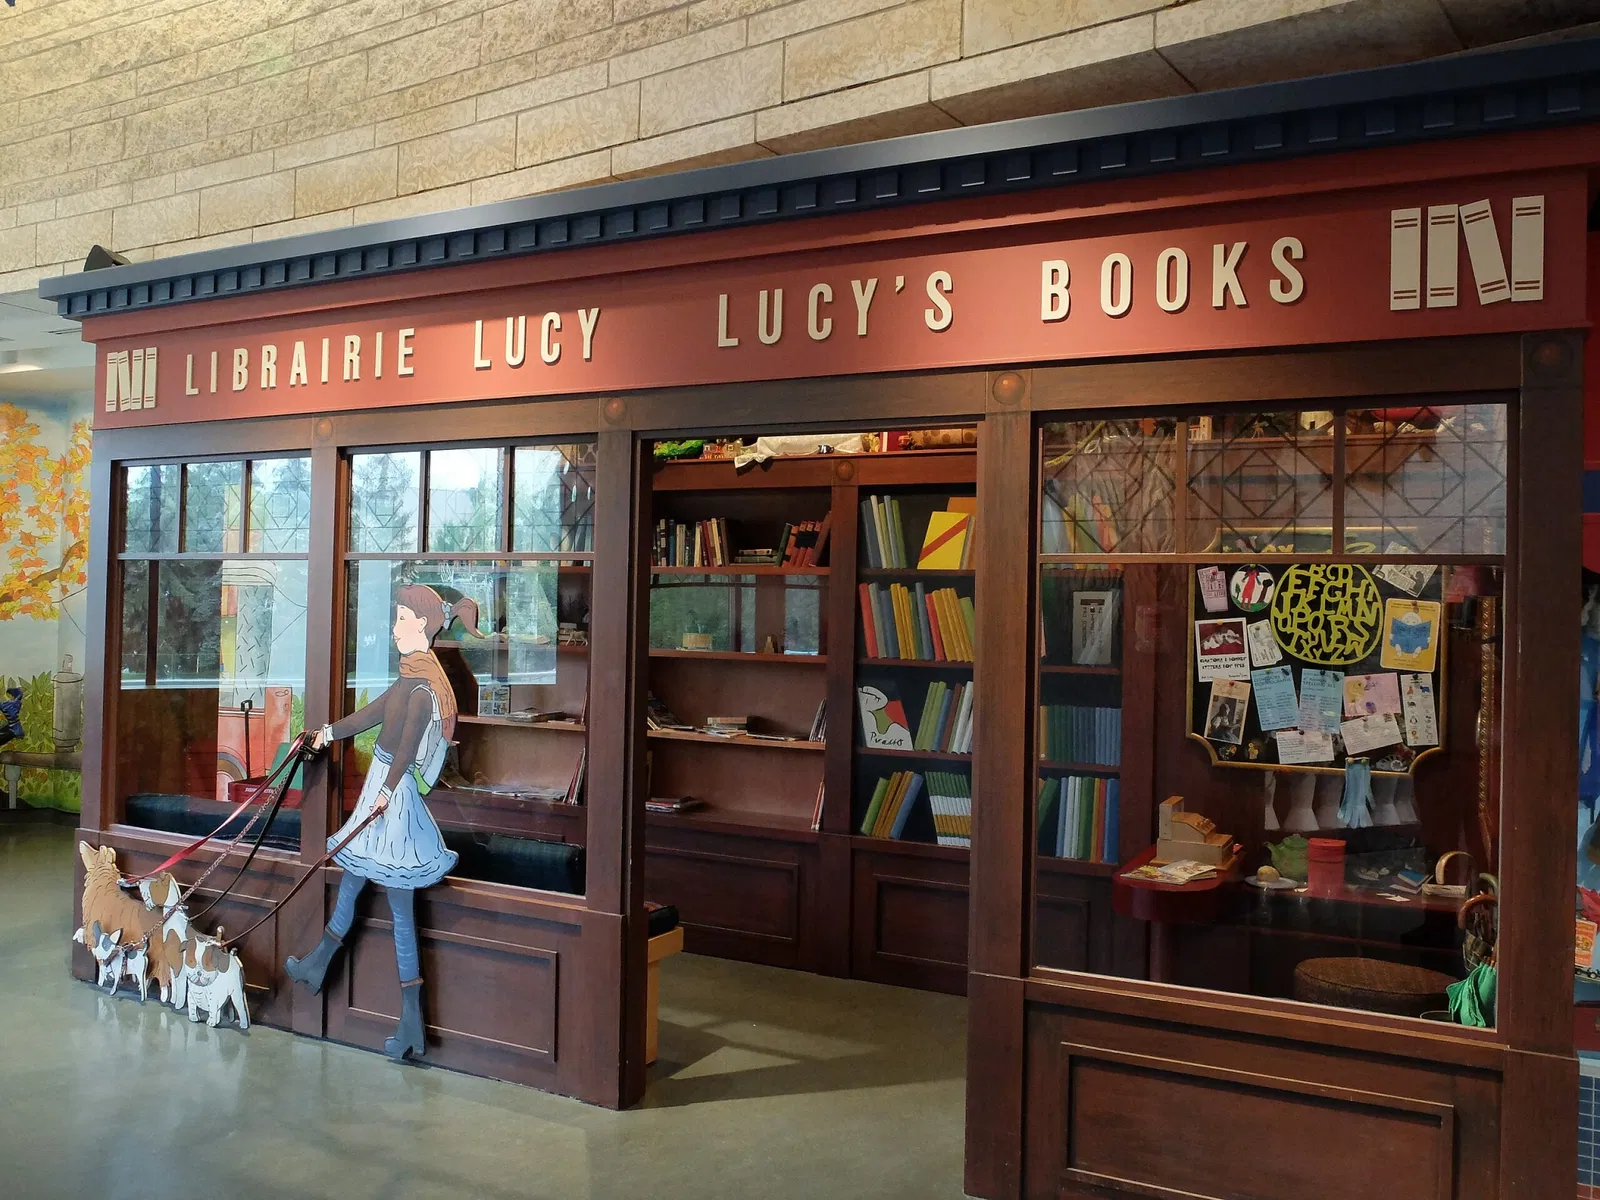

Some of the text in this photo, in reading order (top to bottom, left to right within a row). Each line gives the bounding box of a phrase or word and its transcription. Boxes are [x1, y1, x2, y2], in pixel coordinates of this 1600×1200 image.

[717, 236, 1306, 349] LUCY'S BOOKS
[182, 307, 601, 397] LIBRAIRIE LUCY
